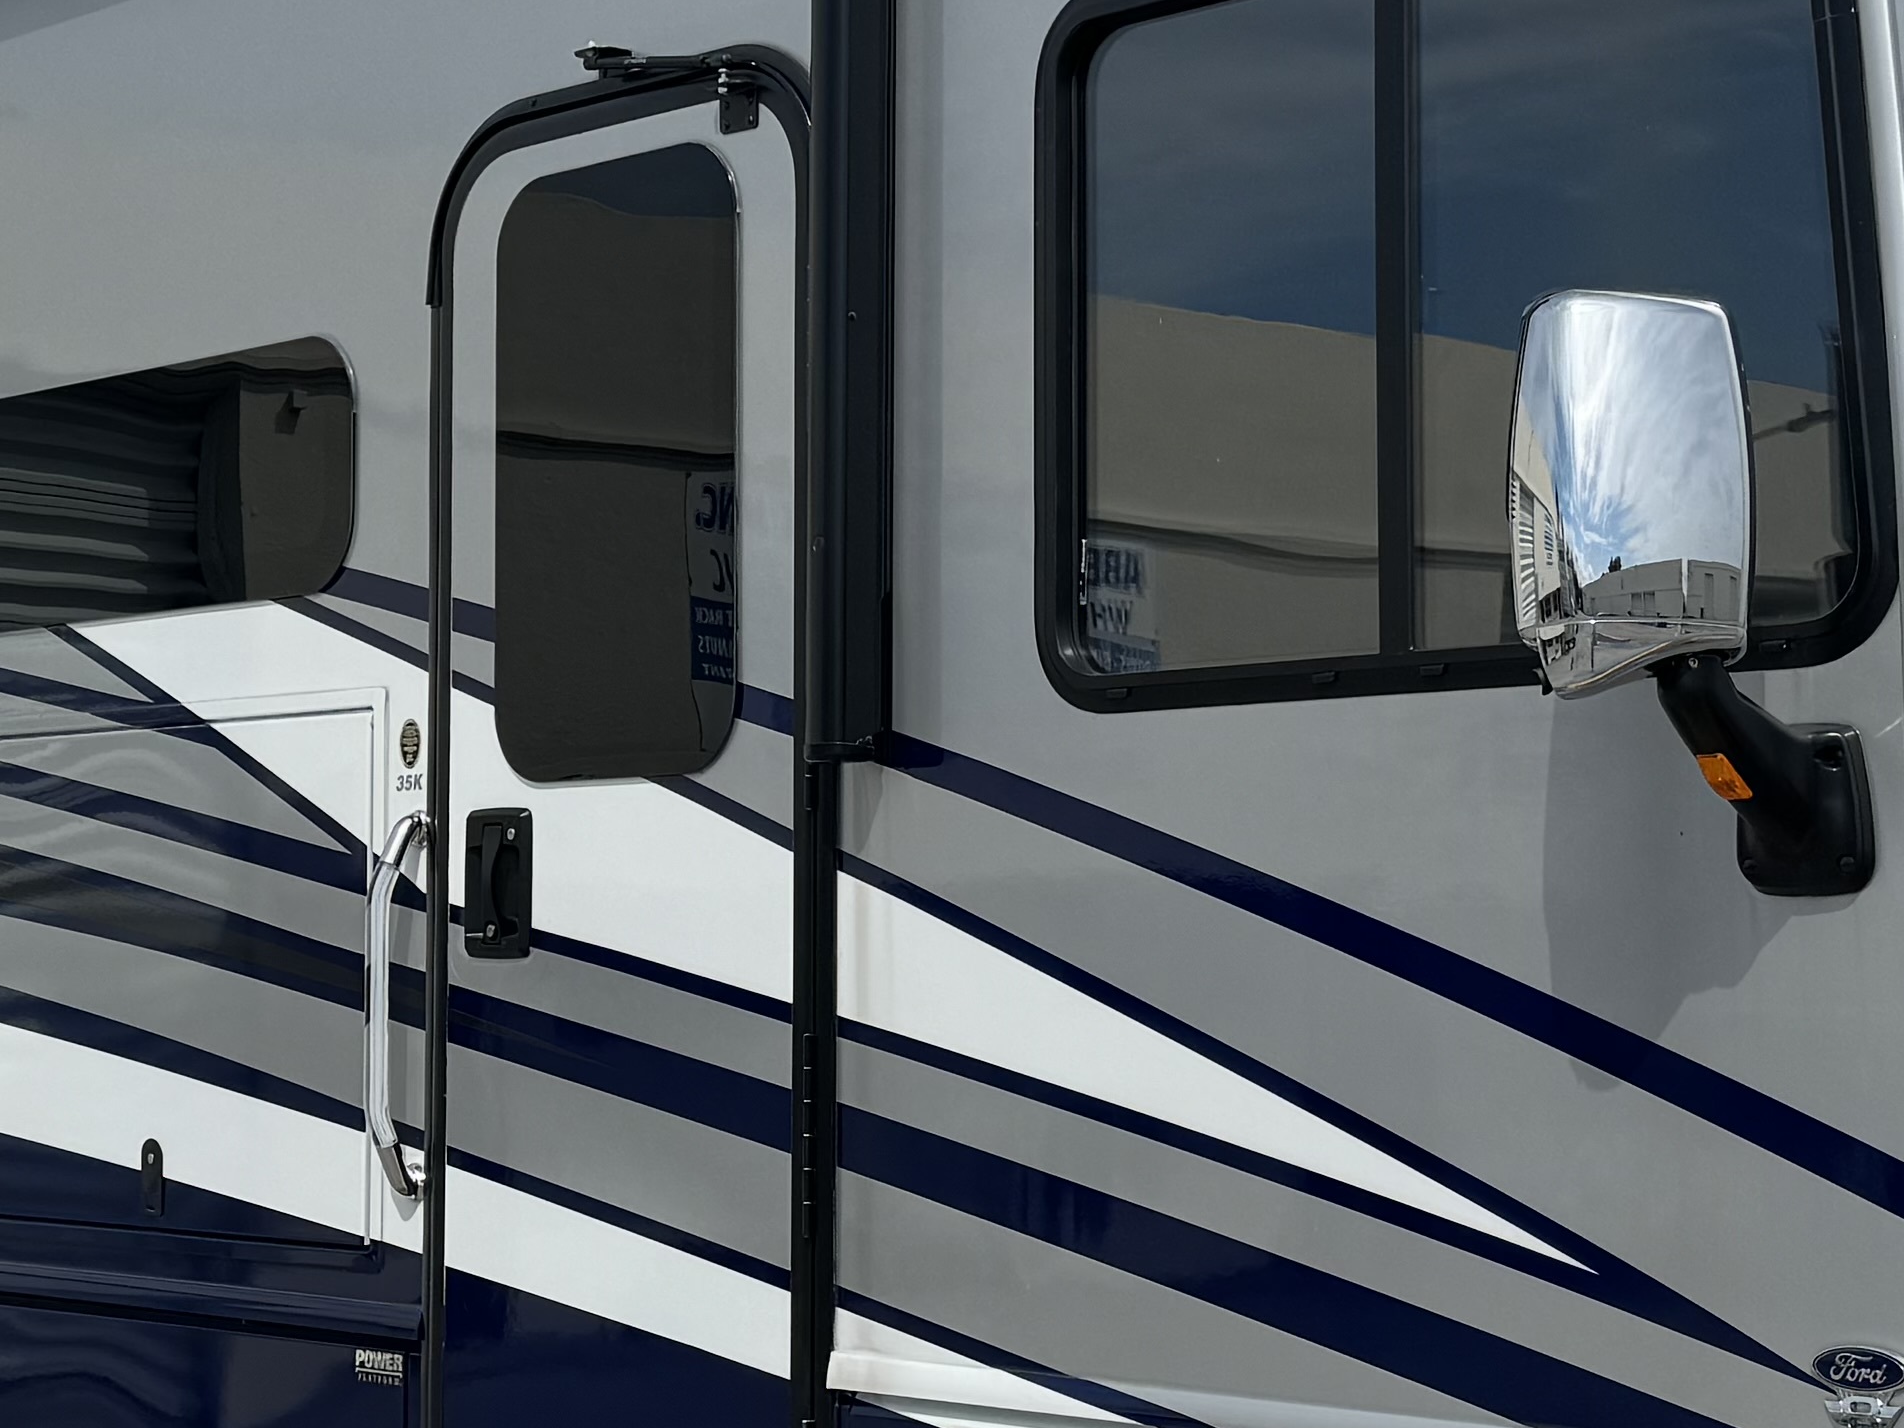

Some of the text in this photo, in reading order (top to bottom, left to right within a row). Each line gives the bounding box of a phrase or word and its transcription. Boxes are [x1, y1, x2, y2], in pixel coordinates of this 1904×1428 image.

[396, 773, 423, 792] 35K
[355, 1349, 403, 1371] POWER
[1829, 1352, 1888, 1385] Ford
